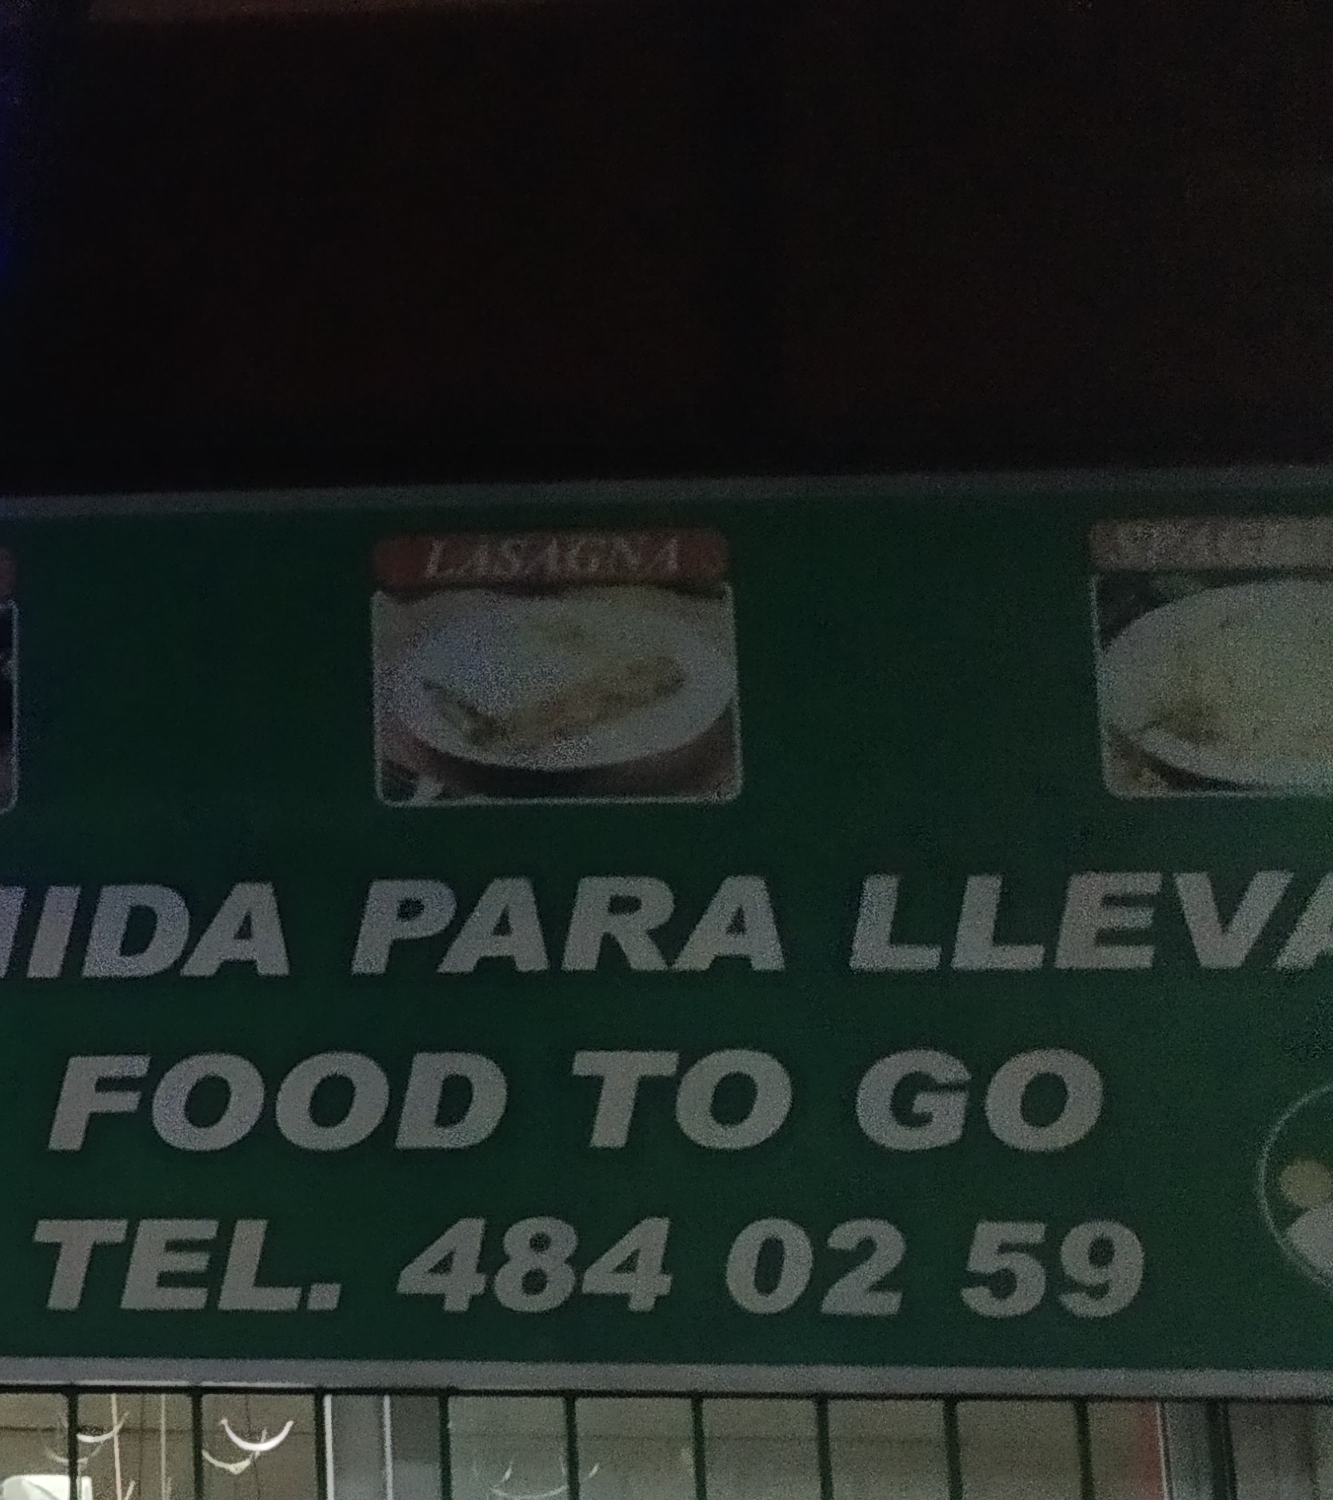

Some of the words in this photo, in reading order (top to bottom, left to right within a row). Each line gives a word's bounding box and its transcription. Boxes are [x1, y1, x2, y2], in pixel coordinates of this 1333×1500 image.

[424, 537, 681, 578] LASAGNA
[350, 874, 786, 975] PARA
[47, 1050, 507, 1152] FOOD
[571, 1048, 793, 1151] TO
[854, 1048, 1104, 1152] GO
[34, 1218, 343, 1311] TEL.
[397, 1216, 673, 1315] 484
[725, 1217, 908, 1318] 02
[961, 1219, 1145, 1320] 59
